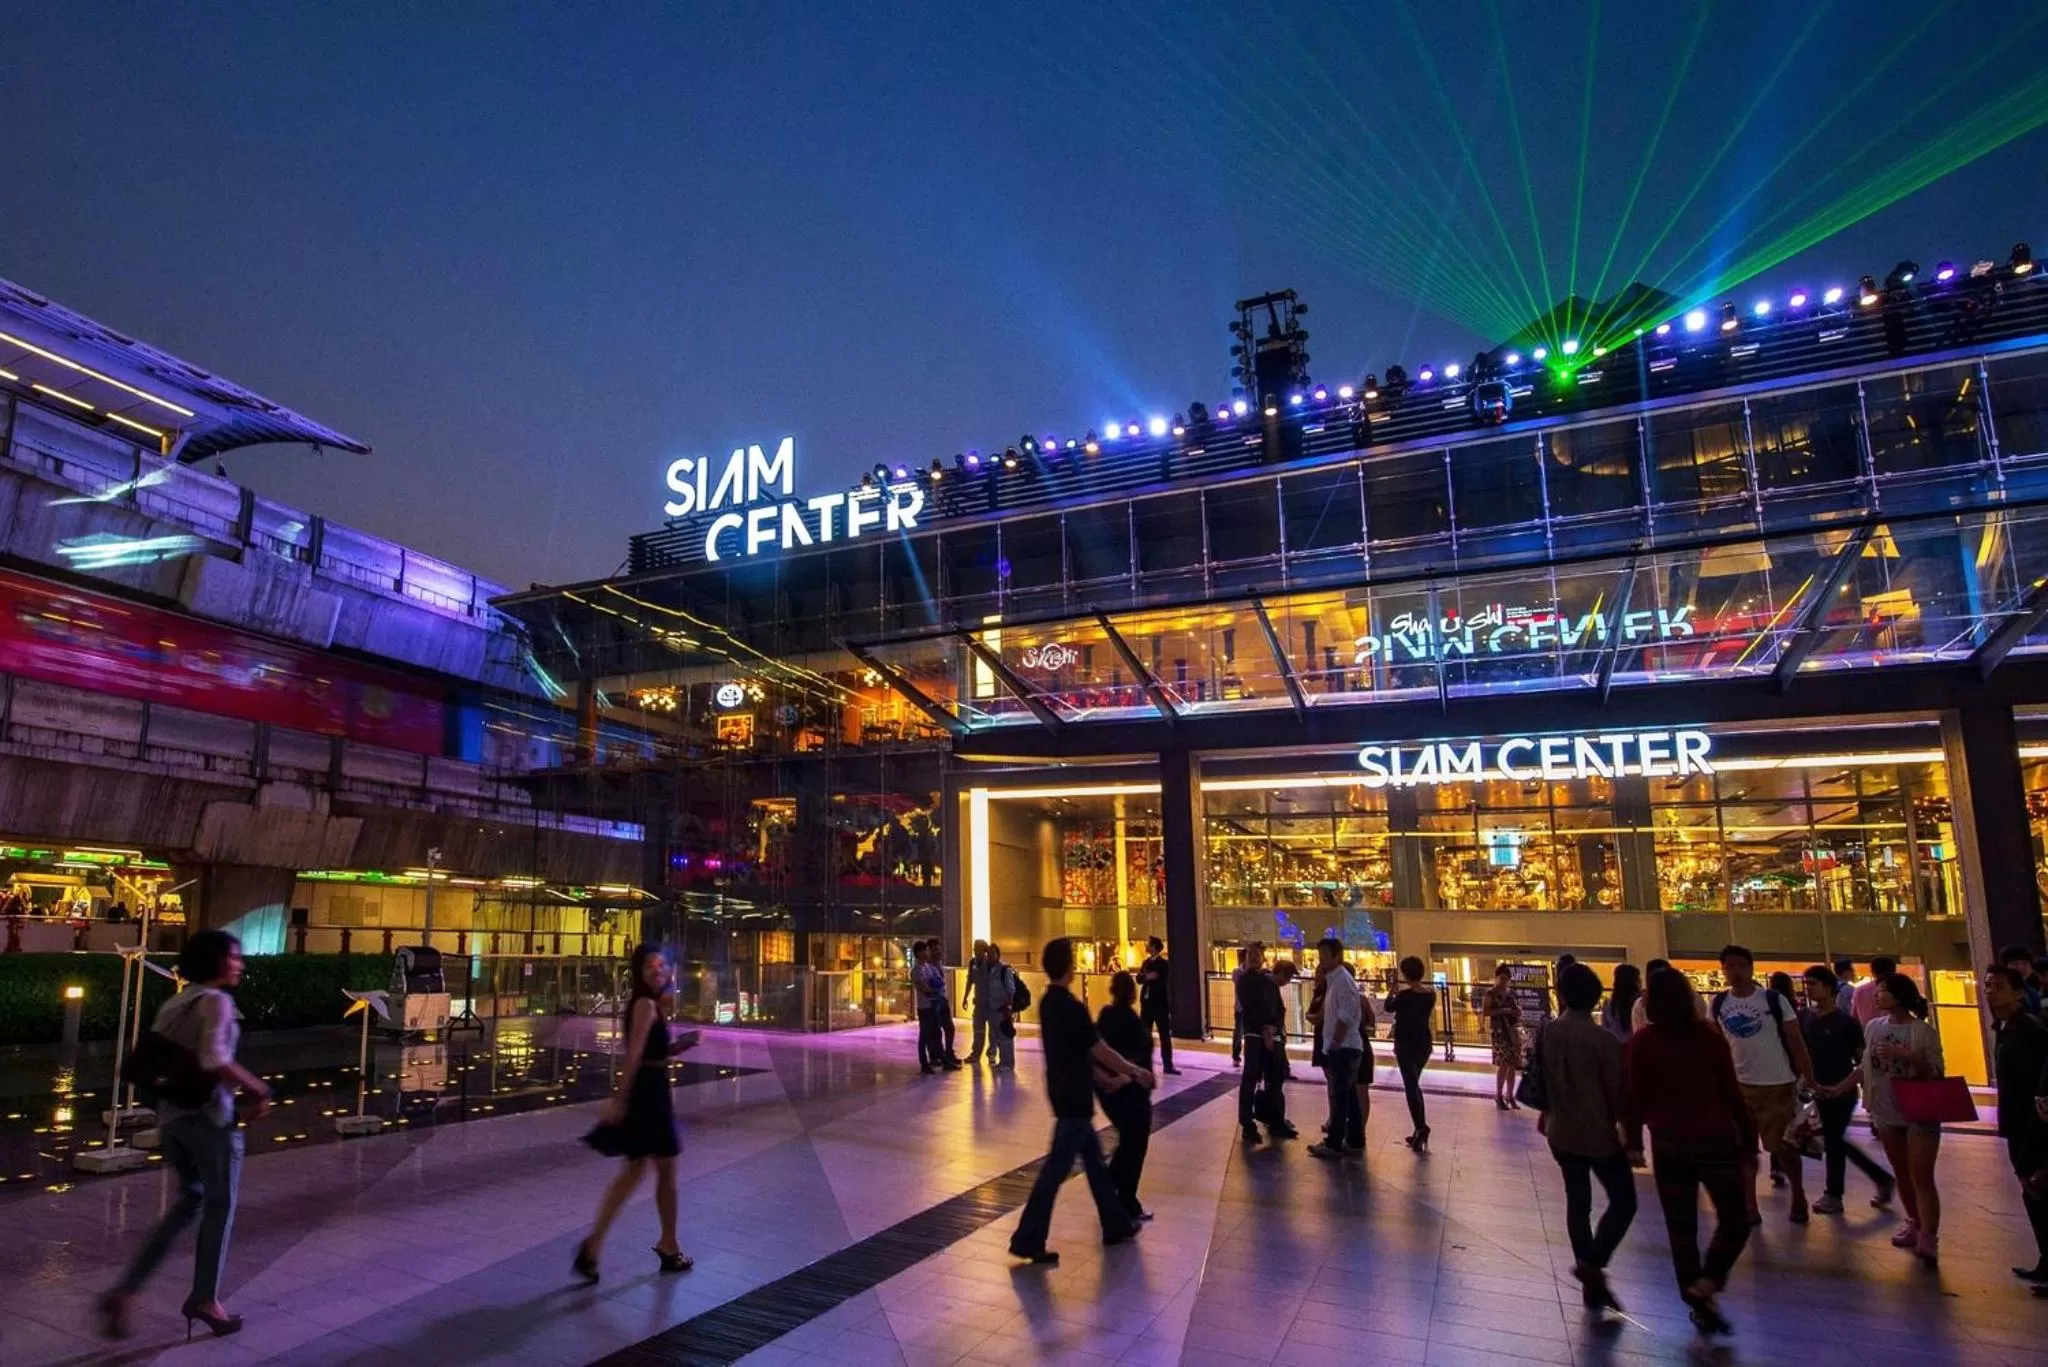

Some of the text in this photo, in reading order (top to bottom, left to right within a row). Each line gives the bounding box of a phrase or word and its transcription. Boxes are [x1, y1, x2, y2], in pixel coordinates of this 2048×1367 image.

[664, 436, 794, 517] SIAM
[705, 481, 924, 562] CENTER
[1358, 730, 1716, 789] SIAM CENTER
